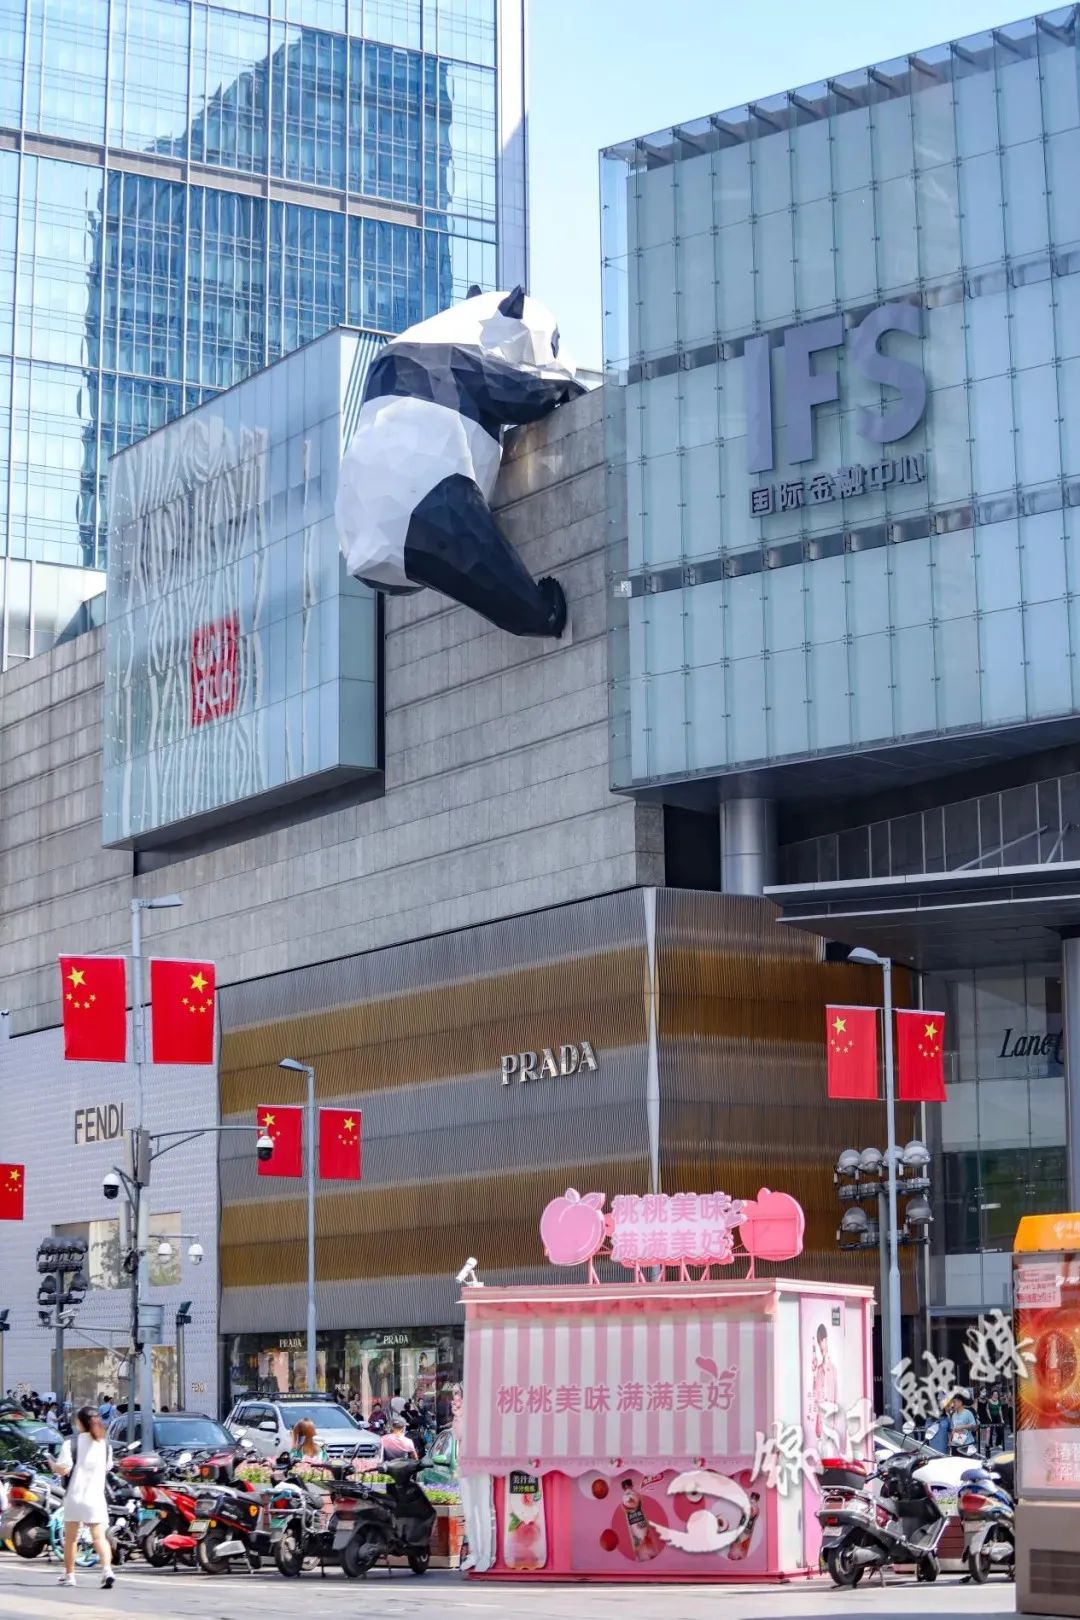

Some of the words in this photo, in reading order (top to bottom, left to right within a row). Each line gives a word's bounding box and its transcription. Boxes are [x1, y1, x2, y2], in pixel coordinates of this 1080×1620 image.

[744, 302, 926, 475] IFS
[751, 454, 928, 518] 国际金融中心
[997, 1028, 1051, 1058] Lane
[501, 1041, 599, 1086] PRADA
[75, 1102, 124, 1144] FENDI
[613, 1197, 726, 1224] 桃桃美味
[612, 1228, 726, 1258] 满满美好
[279, 1338, 302, 1348] PRADA
[383, 1334, 409, 1345] PRADA
